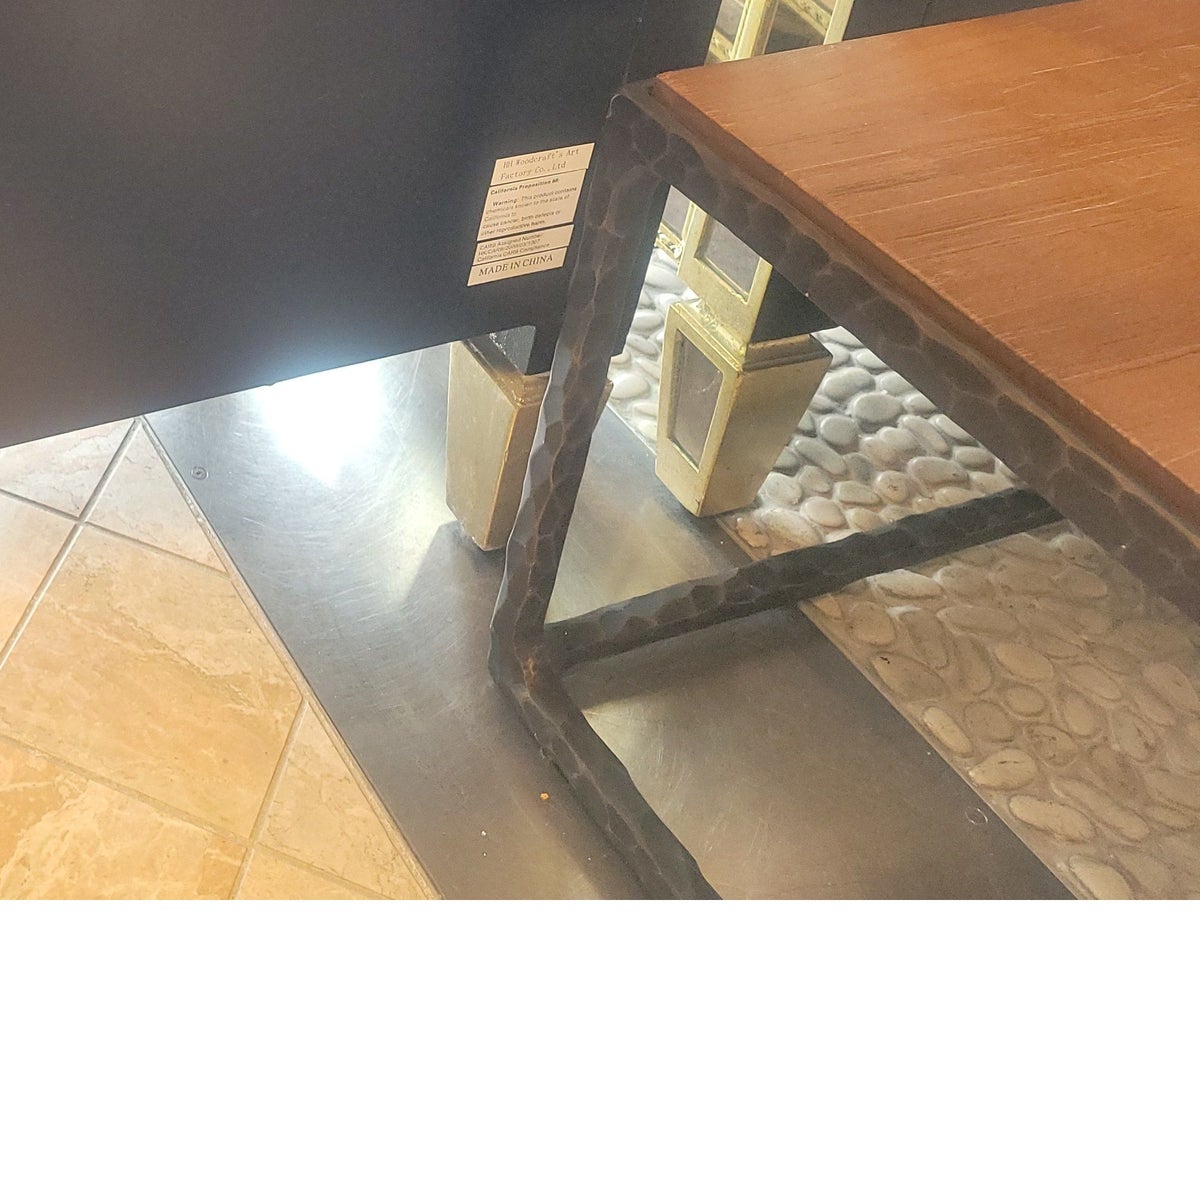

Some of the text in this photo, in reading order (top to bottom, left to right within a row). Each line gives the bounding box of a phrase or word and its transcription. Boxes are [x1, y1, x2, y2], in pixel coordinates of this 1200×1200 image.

[500, 169, 532, 180] Factory
[491, 187, 518, 195] California
[479, 255, 553, 276] MADE IN CHINA
